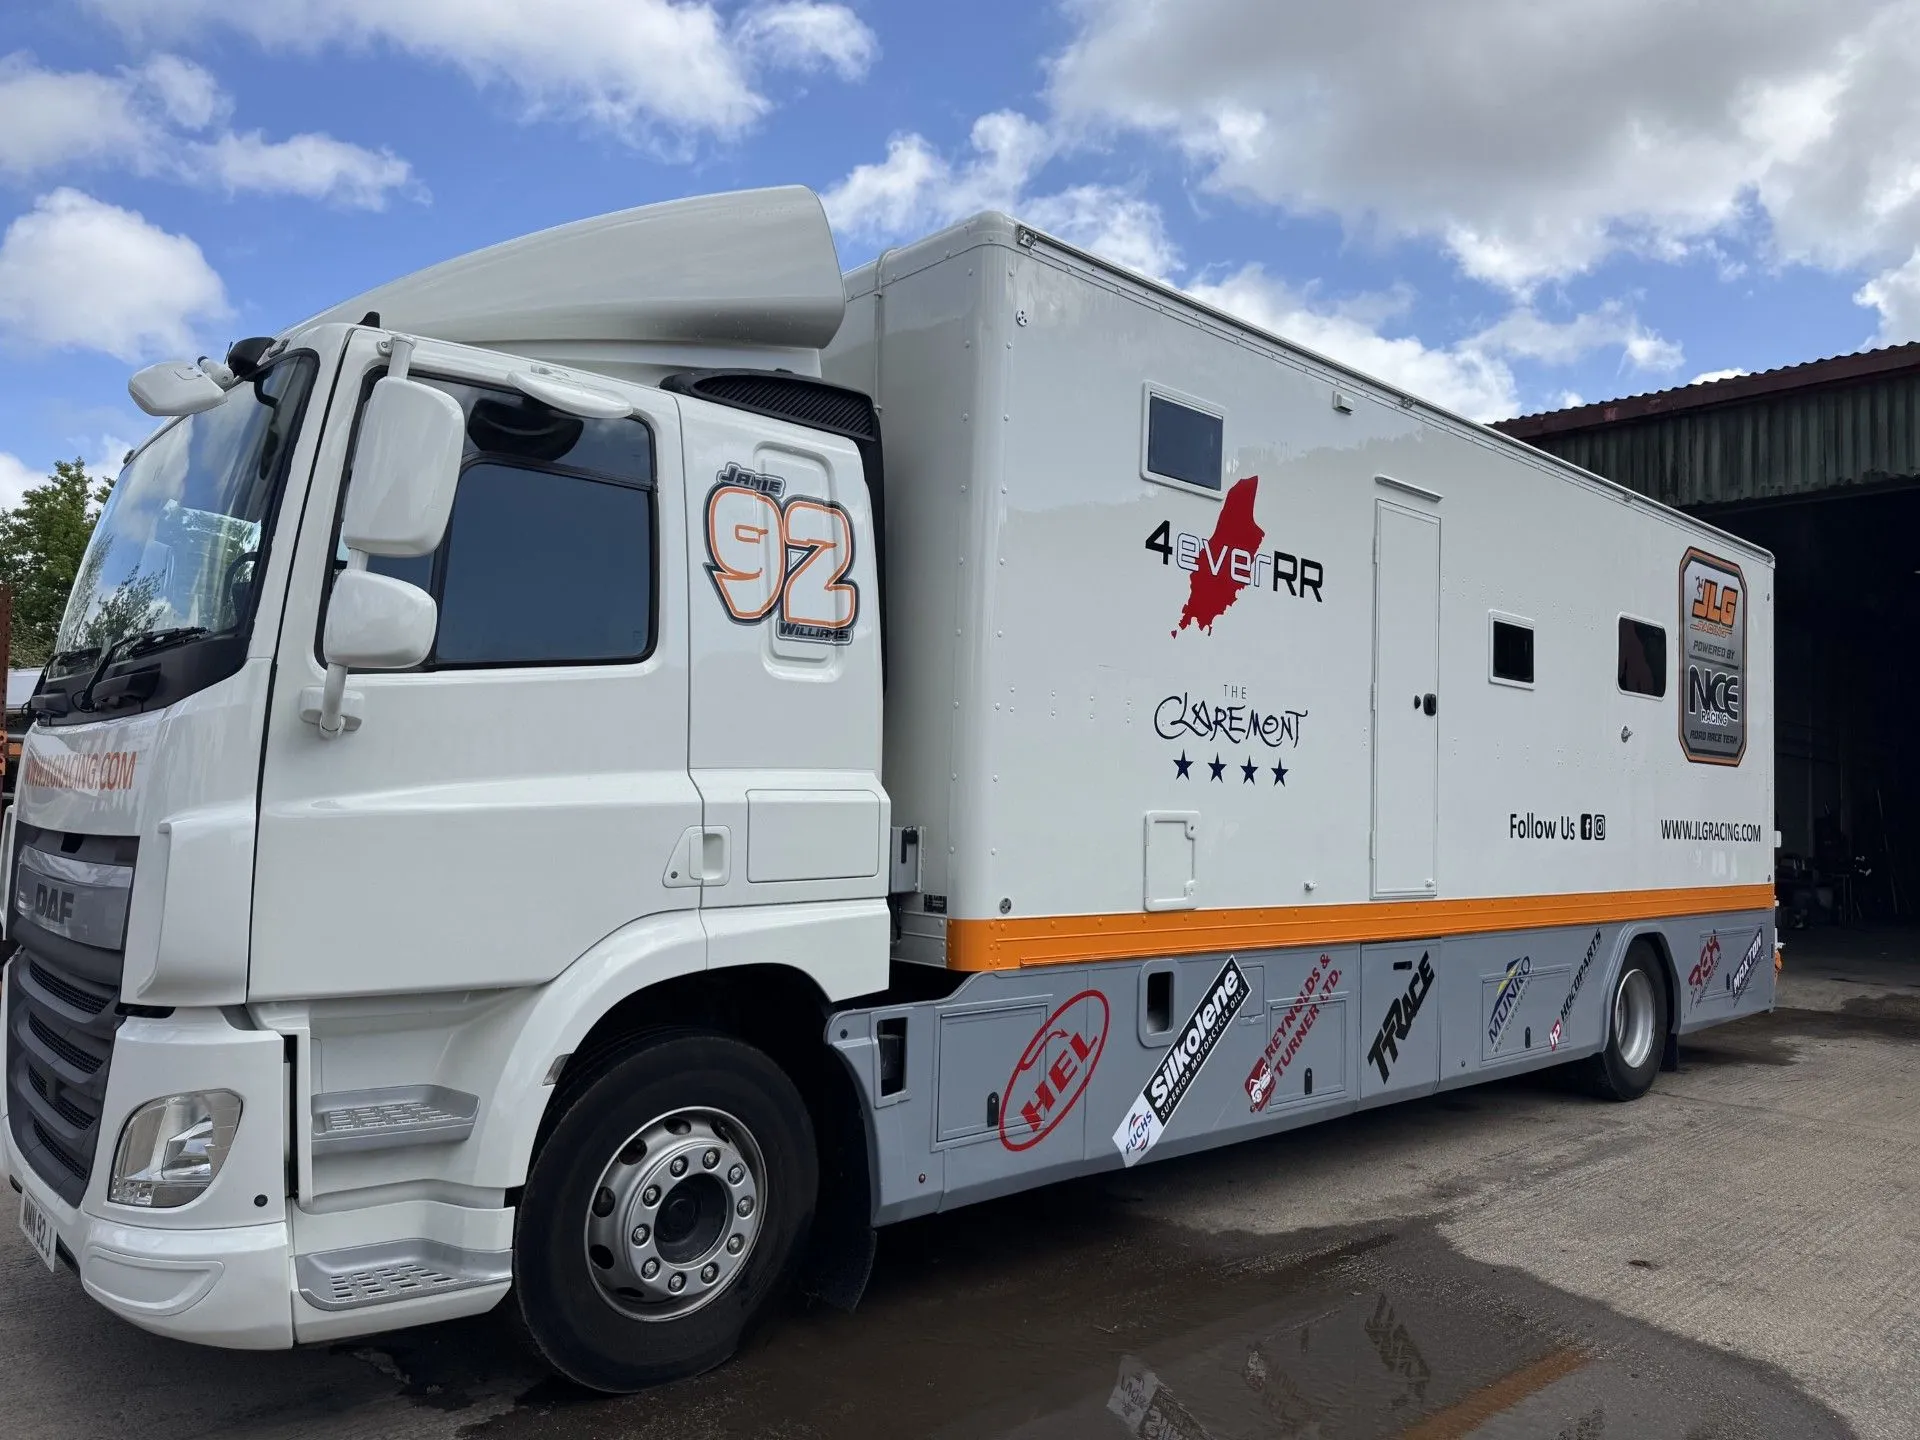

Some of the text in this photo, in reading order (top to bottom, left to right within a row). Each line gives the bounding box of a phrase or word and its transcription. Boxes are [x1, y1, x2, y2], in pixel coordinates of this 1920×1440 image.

[704, 484, 859, 626] 92
[1145, 520, 1323, 602] 4everRR
[1692, 579, 1738, 628] JLG
[1693, 640, 1735, 661] POWERED BY
[1154, 692, 1308, 748] CLAREMONT
[1223, 684, 1247, 700] THE
[1701, 709, 1728, 726] RACING
[1510, 812, 1575, 841] Follow Us
[1660, 819, 1761, 842] WWW.JLGRACING.COM
[34, 883, 74, 925] DAF
[1733, 932, 1762, 994] MAXTON
[1265, 953, 1331, 1060] REYNOLDS &
[1488, 955, 1531, 1044] MUNRO
[1151, 970, 1239, 1109] Silkolene
[1161, 988, 1244, 1119] SUPERIOR MOTORCYCLE OILS
[1274, 1004, 1320, 1077] TURNER
[1020, 1032, 1098, 1133] HEL
[1125, 1110, 1152, 1155] FUCHS
